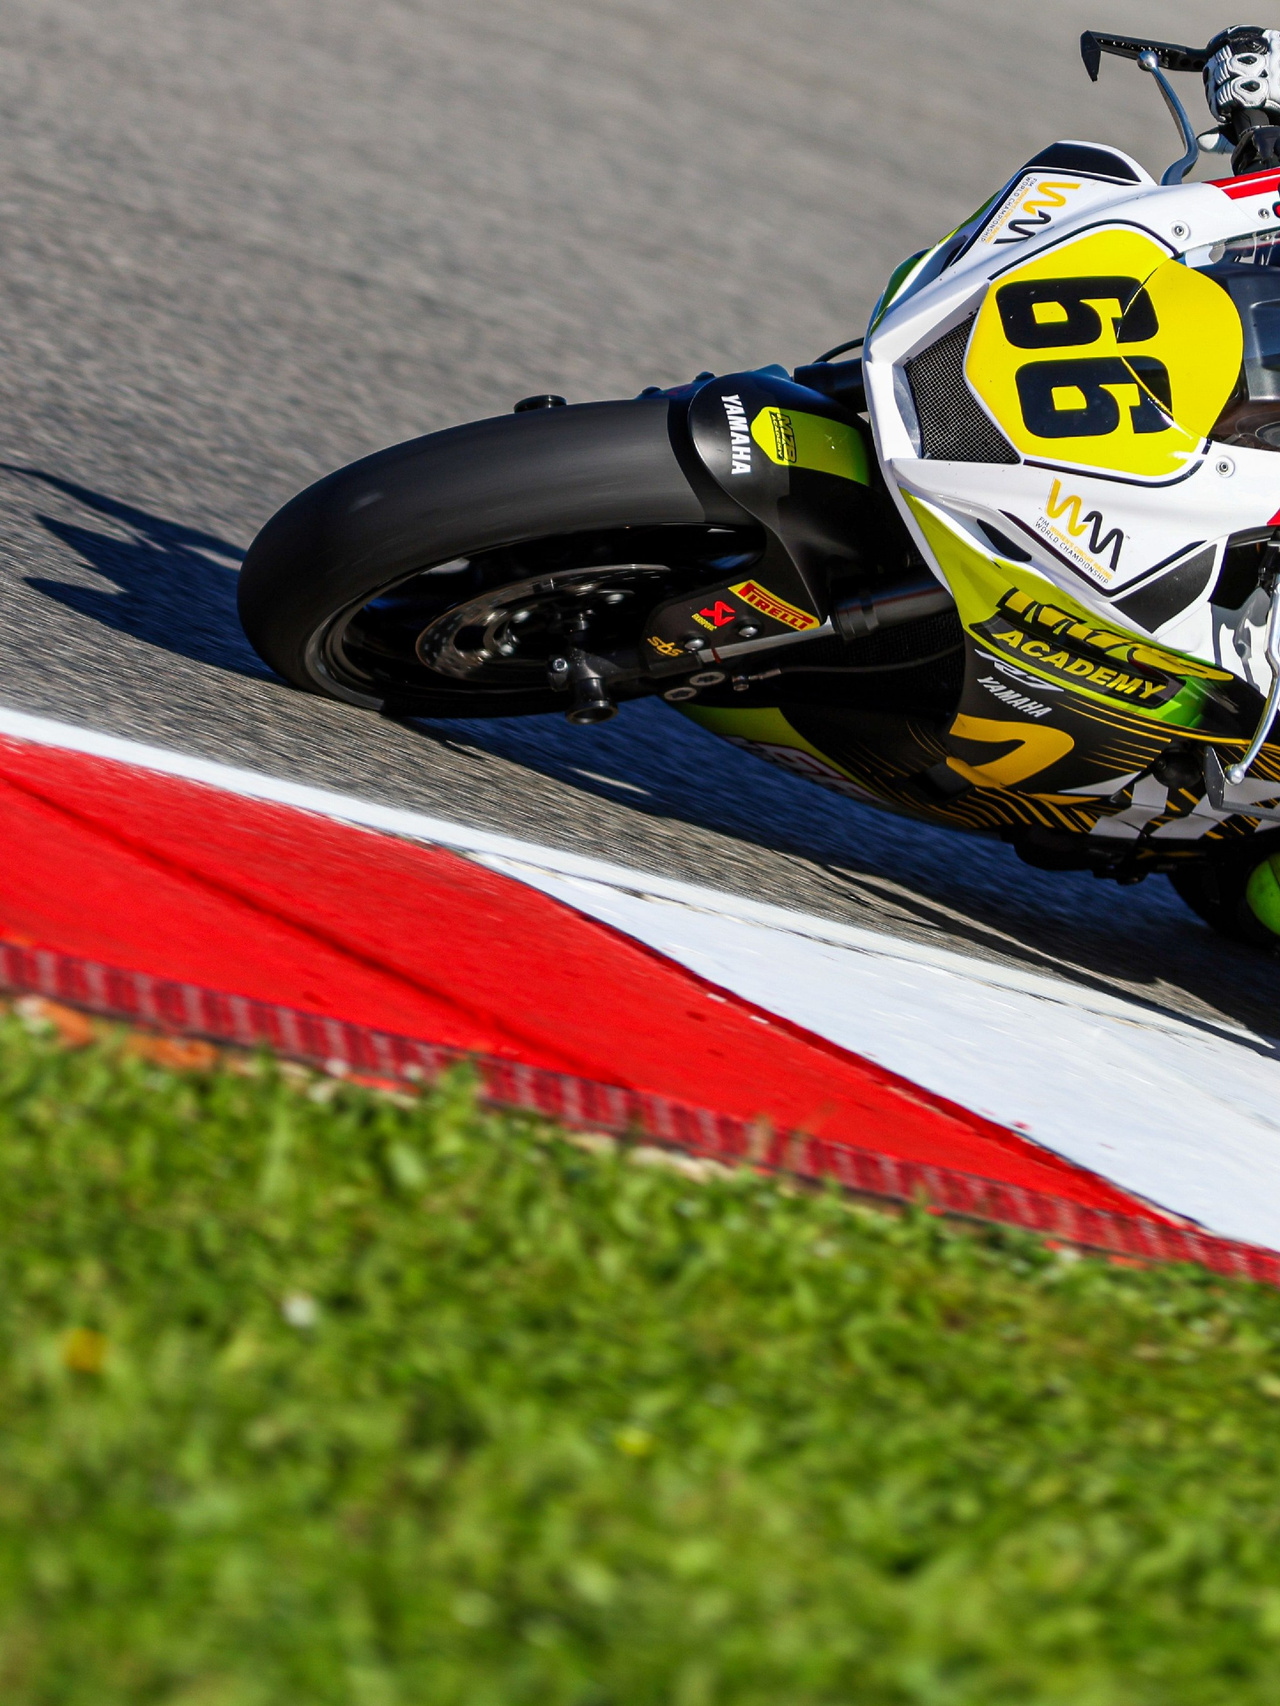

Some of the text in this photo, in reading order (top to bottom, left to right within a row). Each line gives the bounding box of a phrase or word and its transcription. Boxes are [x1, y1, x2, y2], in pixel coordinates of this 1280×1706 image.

[721, 394, 752, 474] YAMAHA
[1039, 516, 1050, 528] FIM
[1035, 521, 1109, 584] WORLD CHAMPIONSHIP
[738, 581, 814, 631] PIRELLI
[991, 629, 1167, 700] ACADEMY
[977, 675, 1053, 718] YAMAHA
